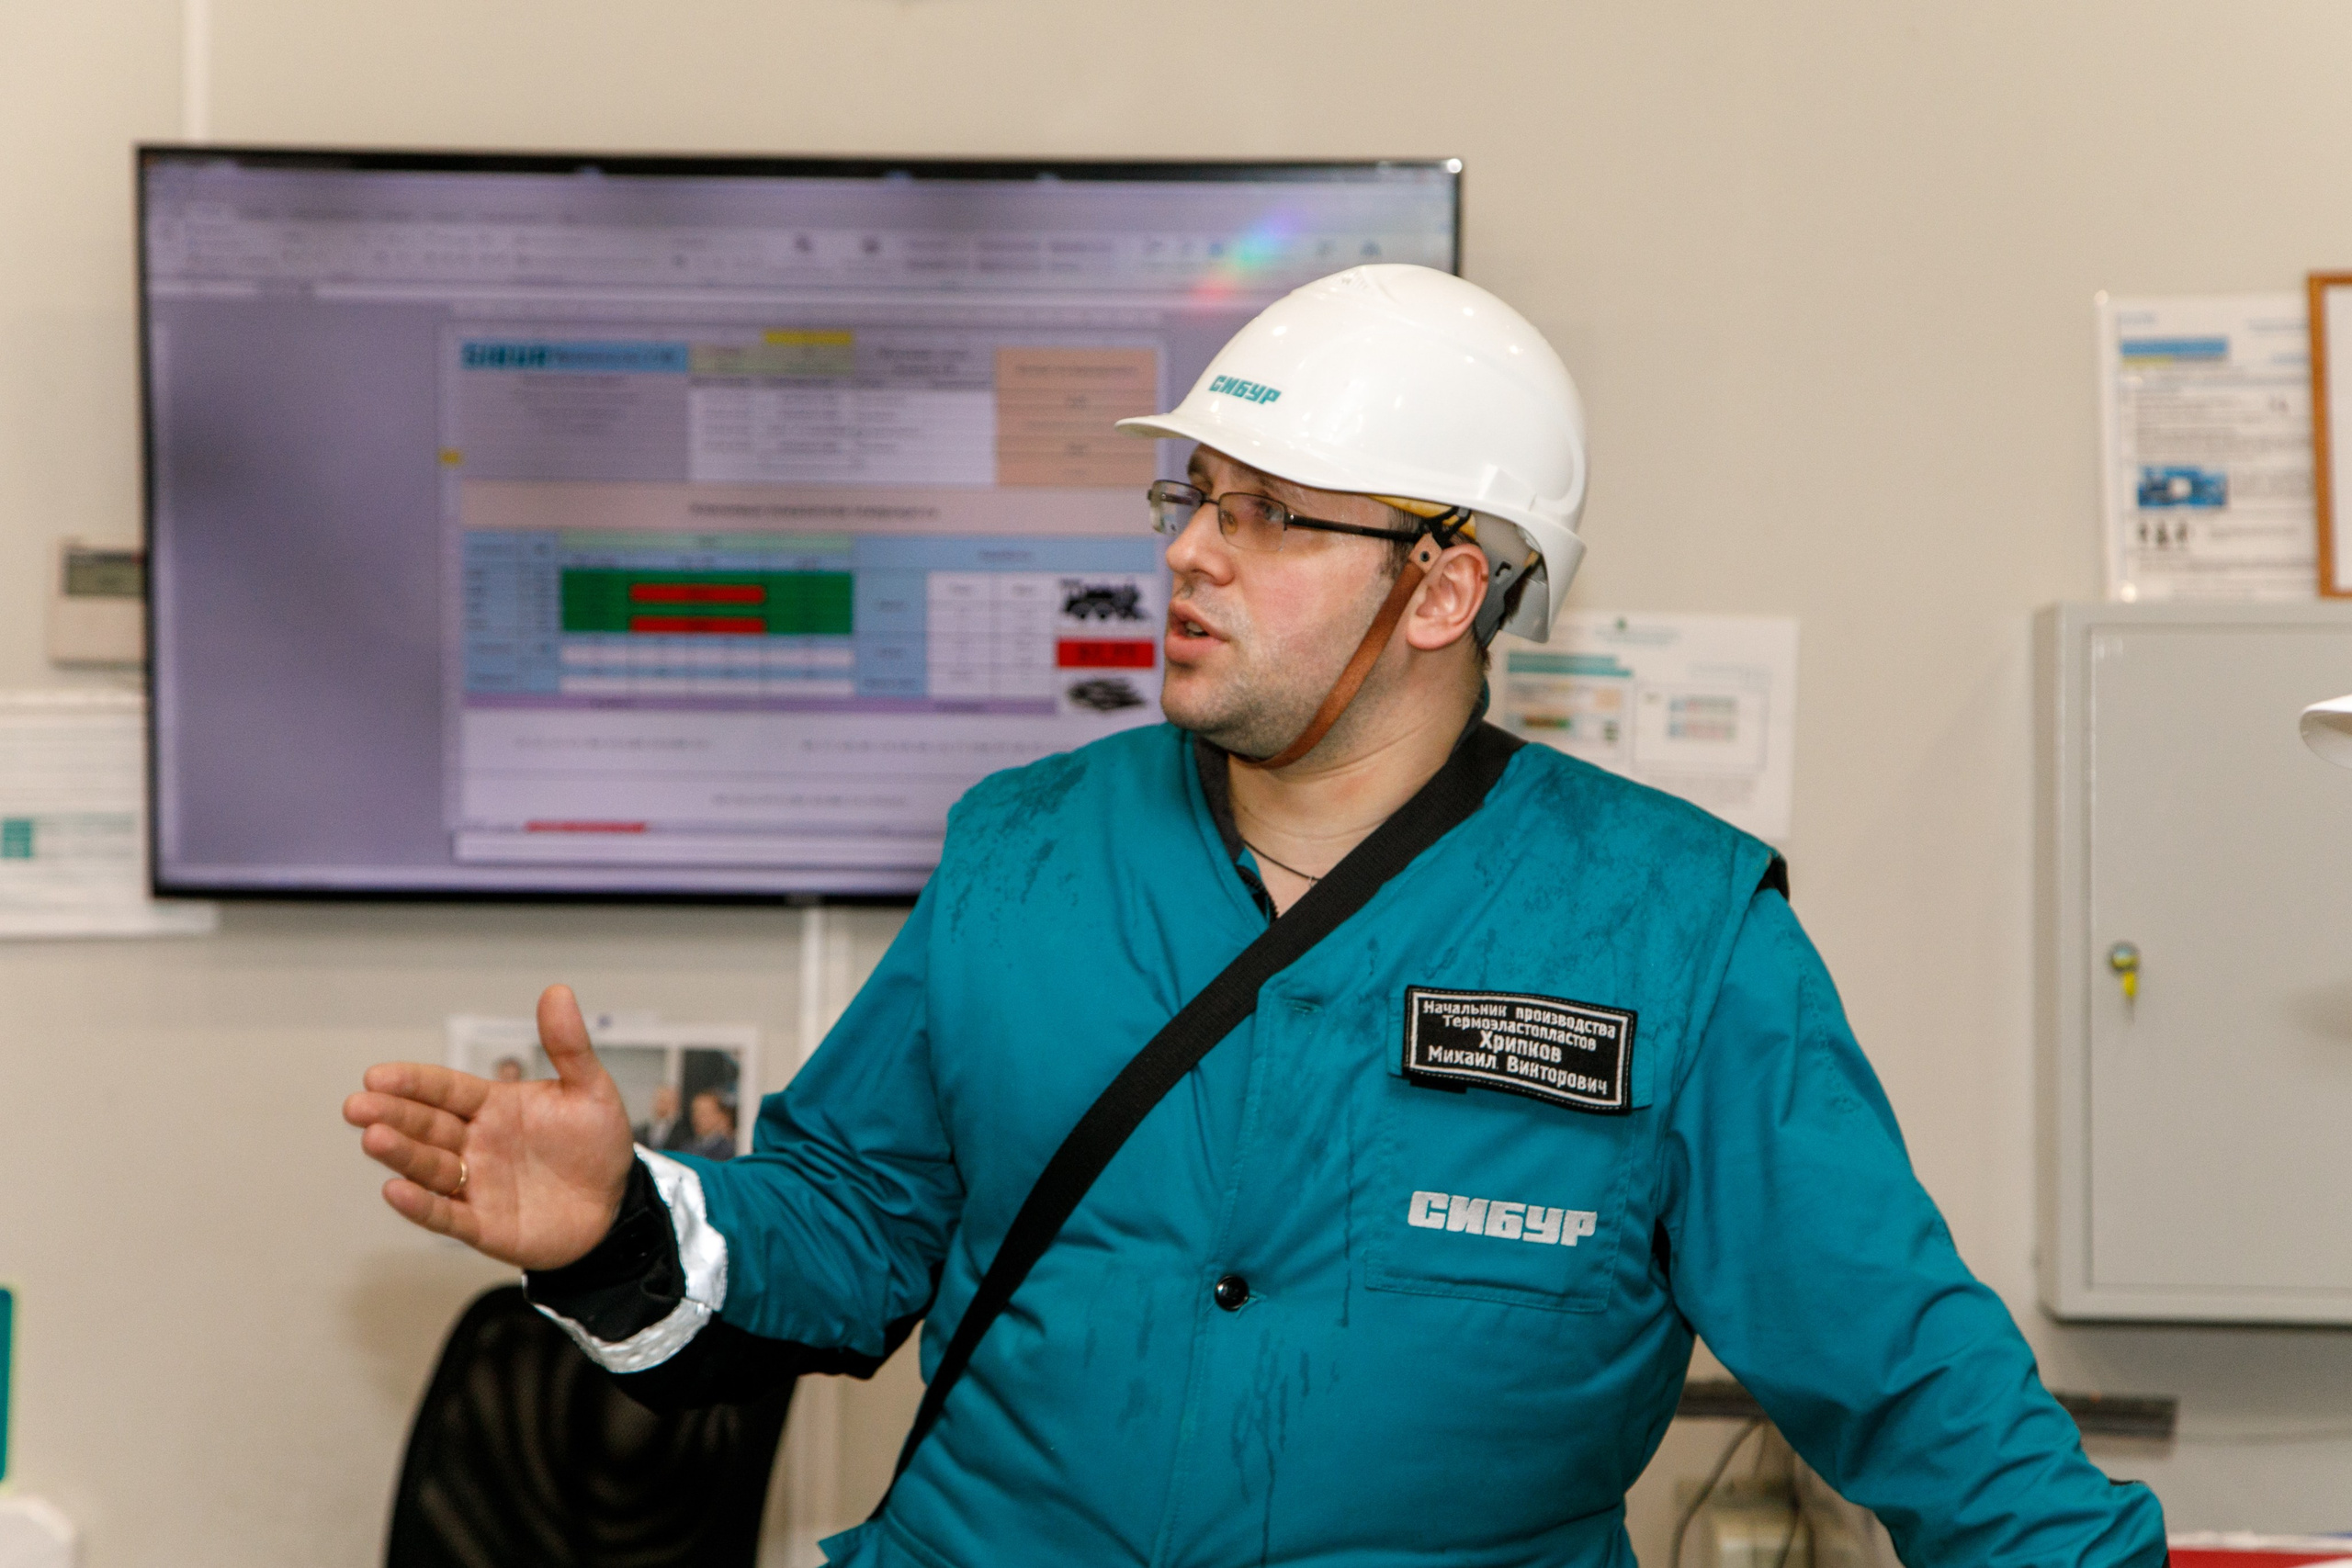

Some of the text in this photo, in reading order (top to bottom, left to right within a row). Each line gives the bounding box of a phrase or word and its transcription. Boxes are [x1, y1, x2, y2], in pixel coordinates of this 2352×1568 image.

[1208, 375, 1282, 405] СИБУР
[1423, 1000, 1616, 1039] Начальник производства
[1442, 1014, 1597, 1052] Термоэластопластов
[1479, 1030, 1563, 1064] Хрипков
[1428, 1044, 1608, 1096] Михаил Викторович
[1408, 1190, 1598, 1247] СИБУР
